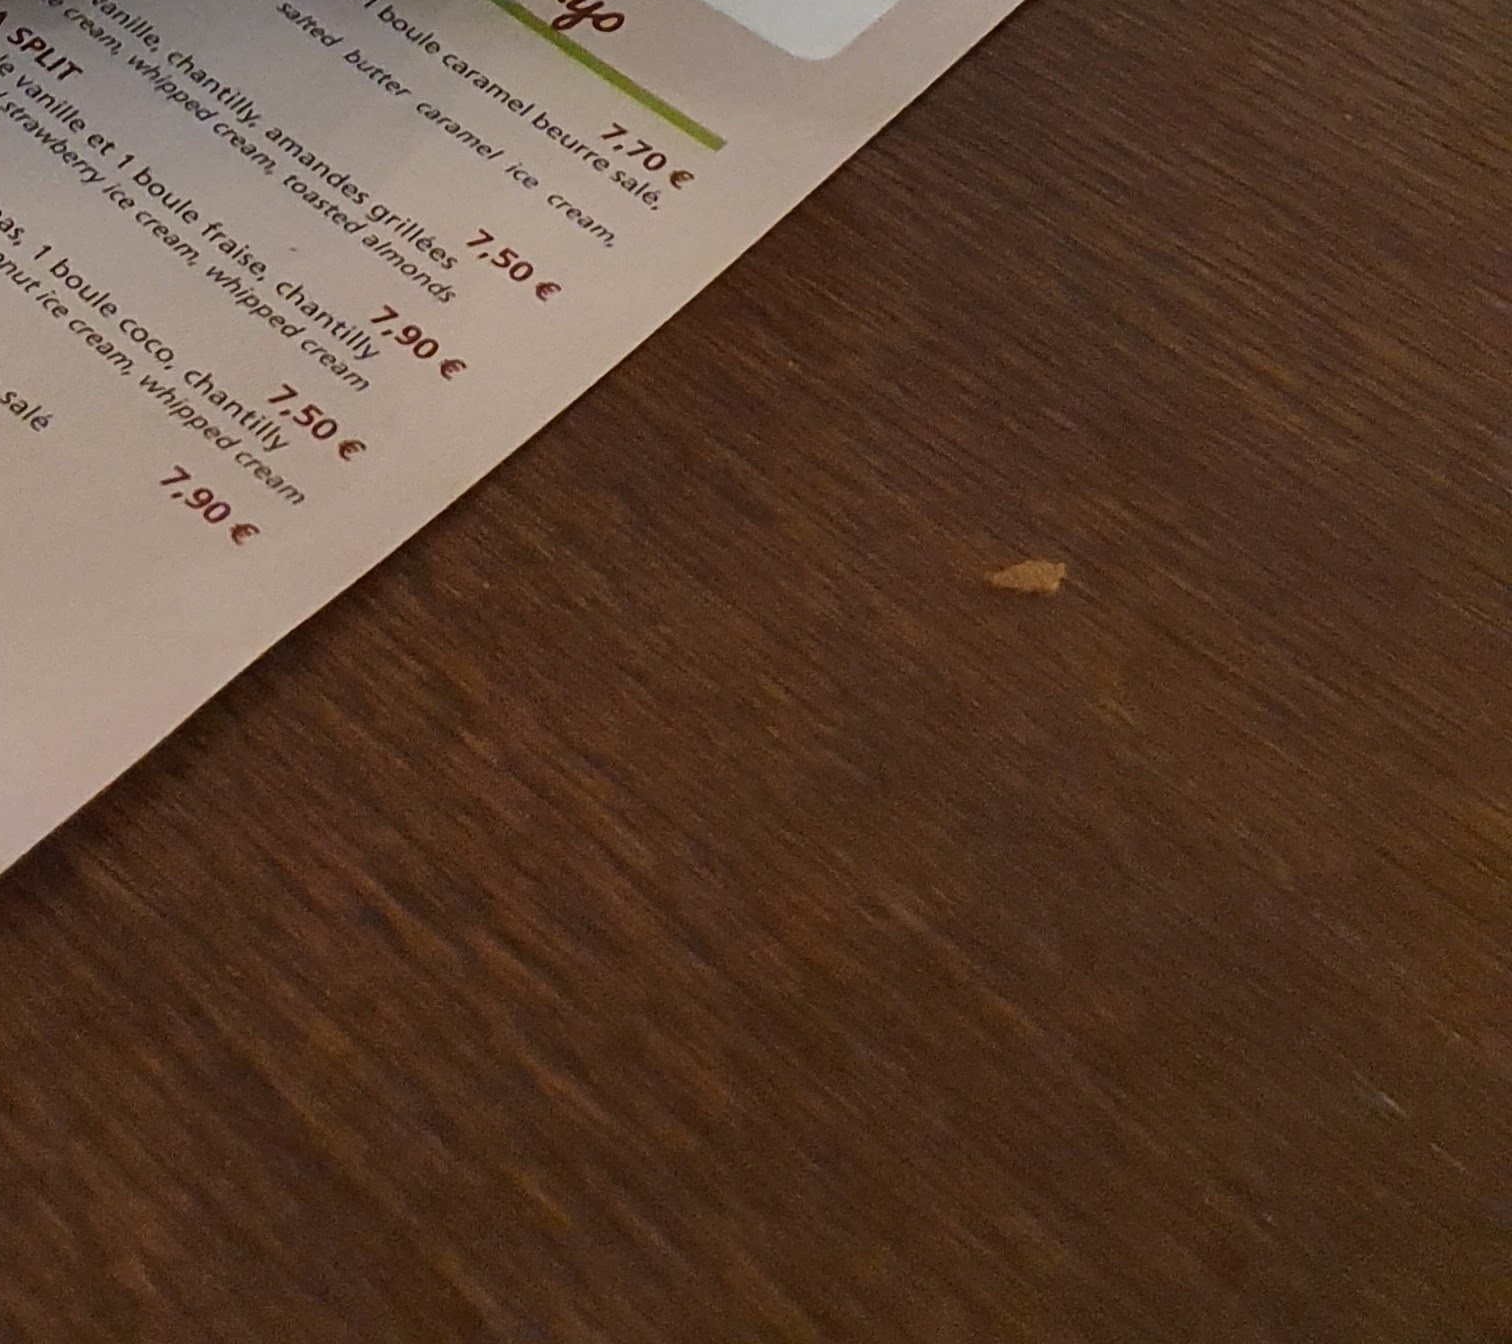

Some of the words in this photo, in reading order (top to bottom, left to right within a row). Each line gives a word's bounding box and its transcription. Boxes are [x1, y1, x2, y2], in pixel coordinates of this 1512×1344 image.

[6, 27, 84, 81] SPLIT
[62, 8, 122, 56] cream,
[127, 54, 220, 122] whipped
[212, 122, 277, 176] cream,
[282, 174, 376, 234] toasted
[361, 234, 457, 304] almonds
[276, 2, 344, 47] salted
[342, 49, 412, 96] butter
[415, 102, 505, 160] caramel
[504, 162, 539, 190] ice
[546, 194, 615, 248] cream,
[377, 4, 441, 55] boule
[442, 54, 536, 117] caramel
[530, 111, 610, 172] beurre
[609, 170, 662, 211] salé,
[599, 122, 667, 172] 7,70
[16, 74, 86, 134] vanille
[87, 133, 116, 157] et
[117, 154, 135, 170] 1
[131, 166, 199, 225] boule
[201, 221, 267, 282] fraise,
[275, 281, 381, 361] chantilly
[167, 51, 262, 128] chantilly,
[264, 127, 370, 205] amandes
[364, 204, 458, 271] grillées
[466, 228, 534, 283] 7,50
[33, 244, 52, 261] 1
[48, 257, 118, 319] boule
[118, 318, 175, 371] coco,
[183, 370, 290, 453] chantilly
[101, 182, 135, 211] ice
[135, 210, 200, 267] cream,
[205, 265, 307, 339] whipped
[300, 339, 370, 392] cream
[369, 304, 440, 360] 7,90
[35, 289, 69, 319] ice
[68, 319, 134, 376] cream,
[139, 374, 243, 451] whipped
[234, 451, 306, 506] cream
[159, 465, 232, 524] 7,90
[267, 383, 339, 441] 7,50
